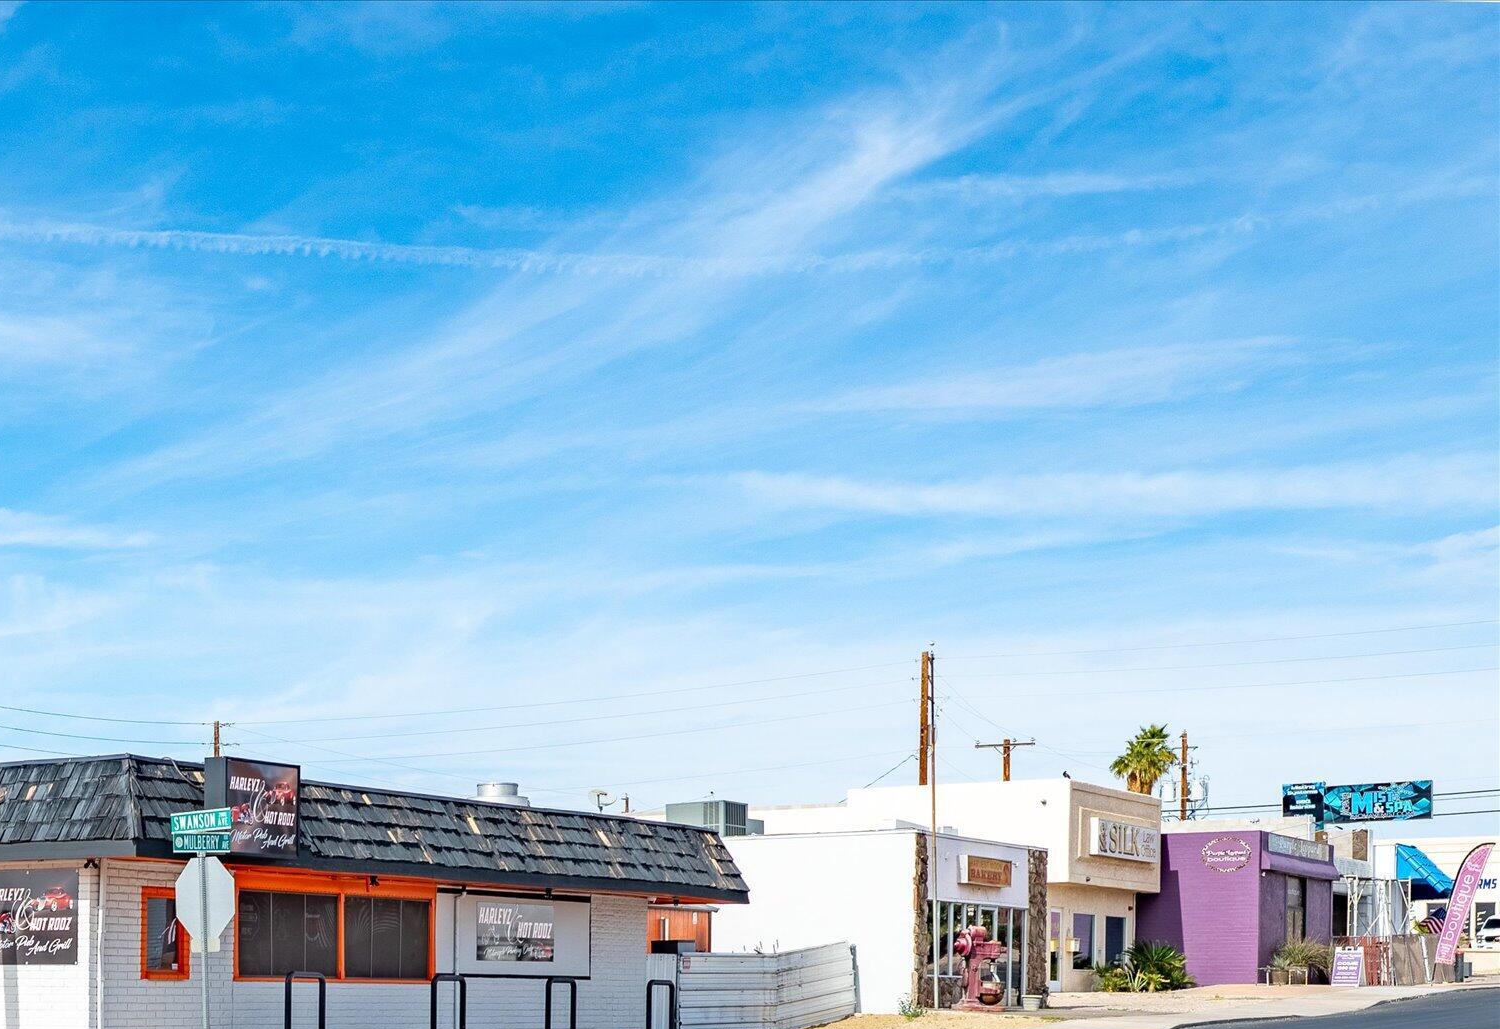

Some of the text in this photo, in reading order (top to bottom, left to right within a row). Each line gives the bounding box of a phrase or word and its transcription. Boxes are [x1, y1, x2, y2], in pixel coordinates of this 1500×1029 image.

[229, 776, 261, 792] HARLEYZ
[1351, 791, 1394, 814] MIST
[1374, 799, 1413, 814] & SPA
[174, 812, 229, 831] SWANSON AVE
[264, 811, 296, 826] HOT RODZ
[183, 835, 220, 850] MULBERRY
[222, 841, 230, 850] AVE
[230, 829, 251, 844] Motor
[252, 828, 268, 841] Pub
[261, 834, 296, 850] And Grill
[1109, 822, 1140, 857] SILK
[478, 906, 512, 925] HARLEYZ
[1443, 874, 1475, 941] boutique
[29, 917, 73, 931] HOT RODZ
[517, 922, 553, 939] HOT RODZ
[15, 935, 35, 950] Pub
[25, 938, 73, 956] And Grill
